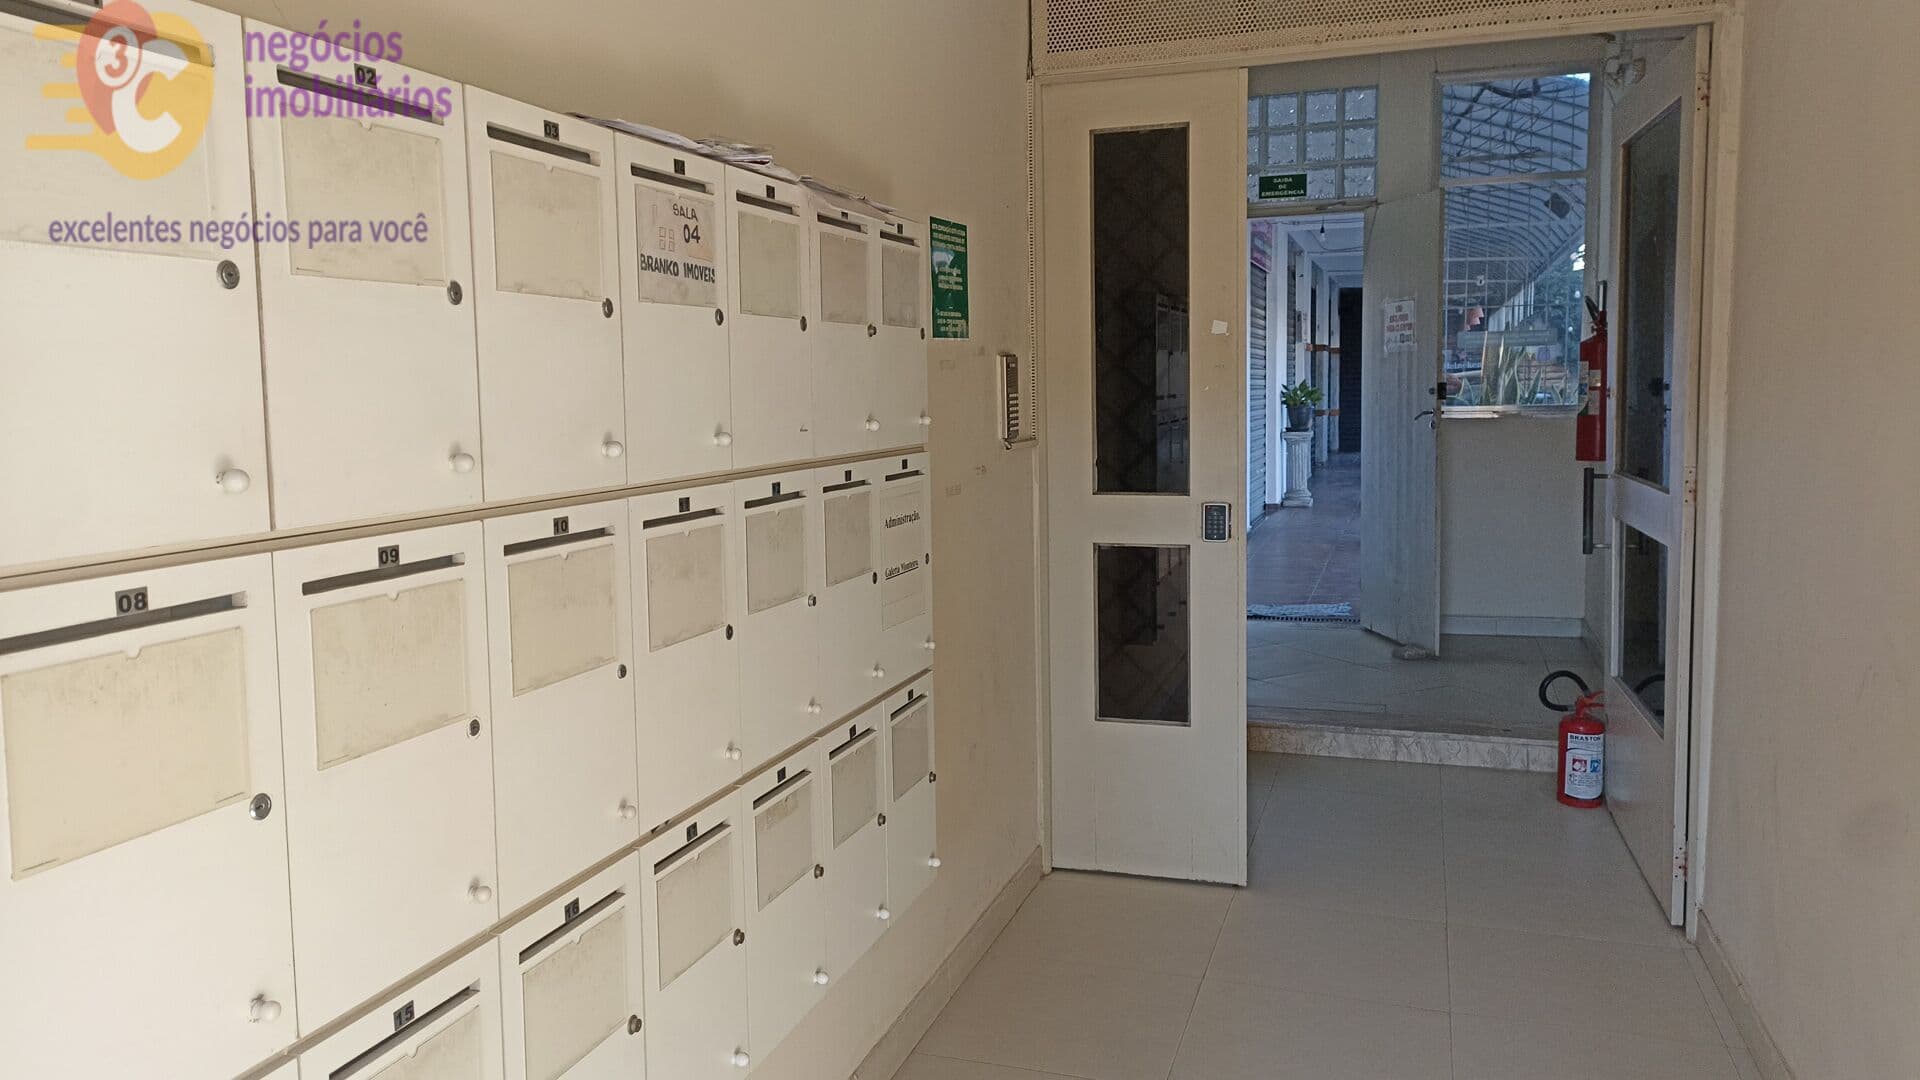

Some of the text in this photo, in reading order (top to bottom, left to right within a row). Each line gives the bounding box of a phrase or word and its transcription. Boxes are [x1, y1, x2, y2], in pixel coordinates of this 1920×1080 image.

[355, 66, 376, 86] 02
[673, 203, 698, 221] SALA
[683, 224, 700, 243] 04
[640, 253, 715, 283] BRANKO IMOVEIS
[553, 518, 569, 534] 10
[379, 547, 399, 565] 09
[118, 592, 147, 613] 08
[395, 1007, 414, 1027] 15
